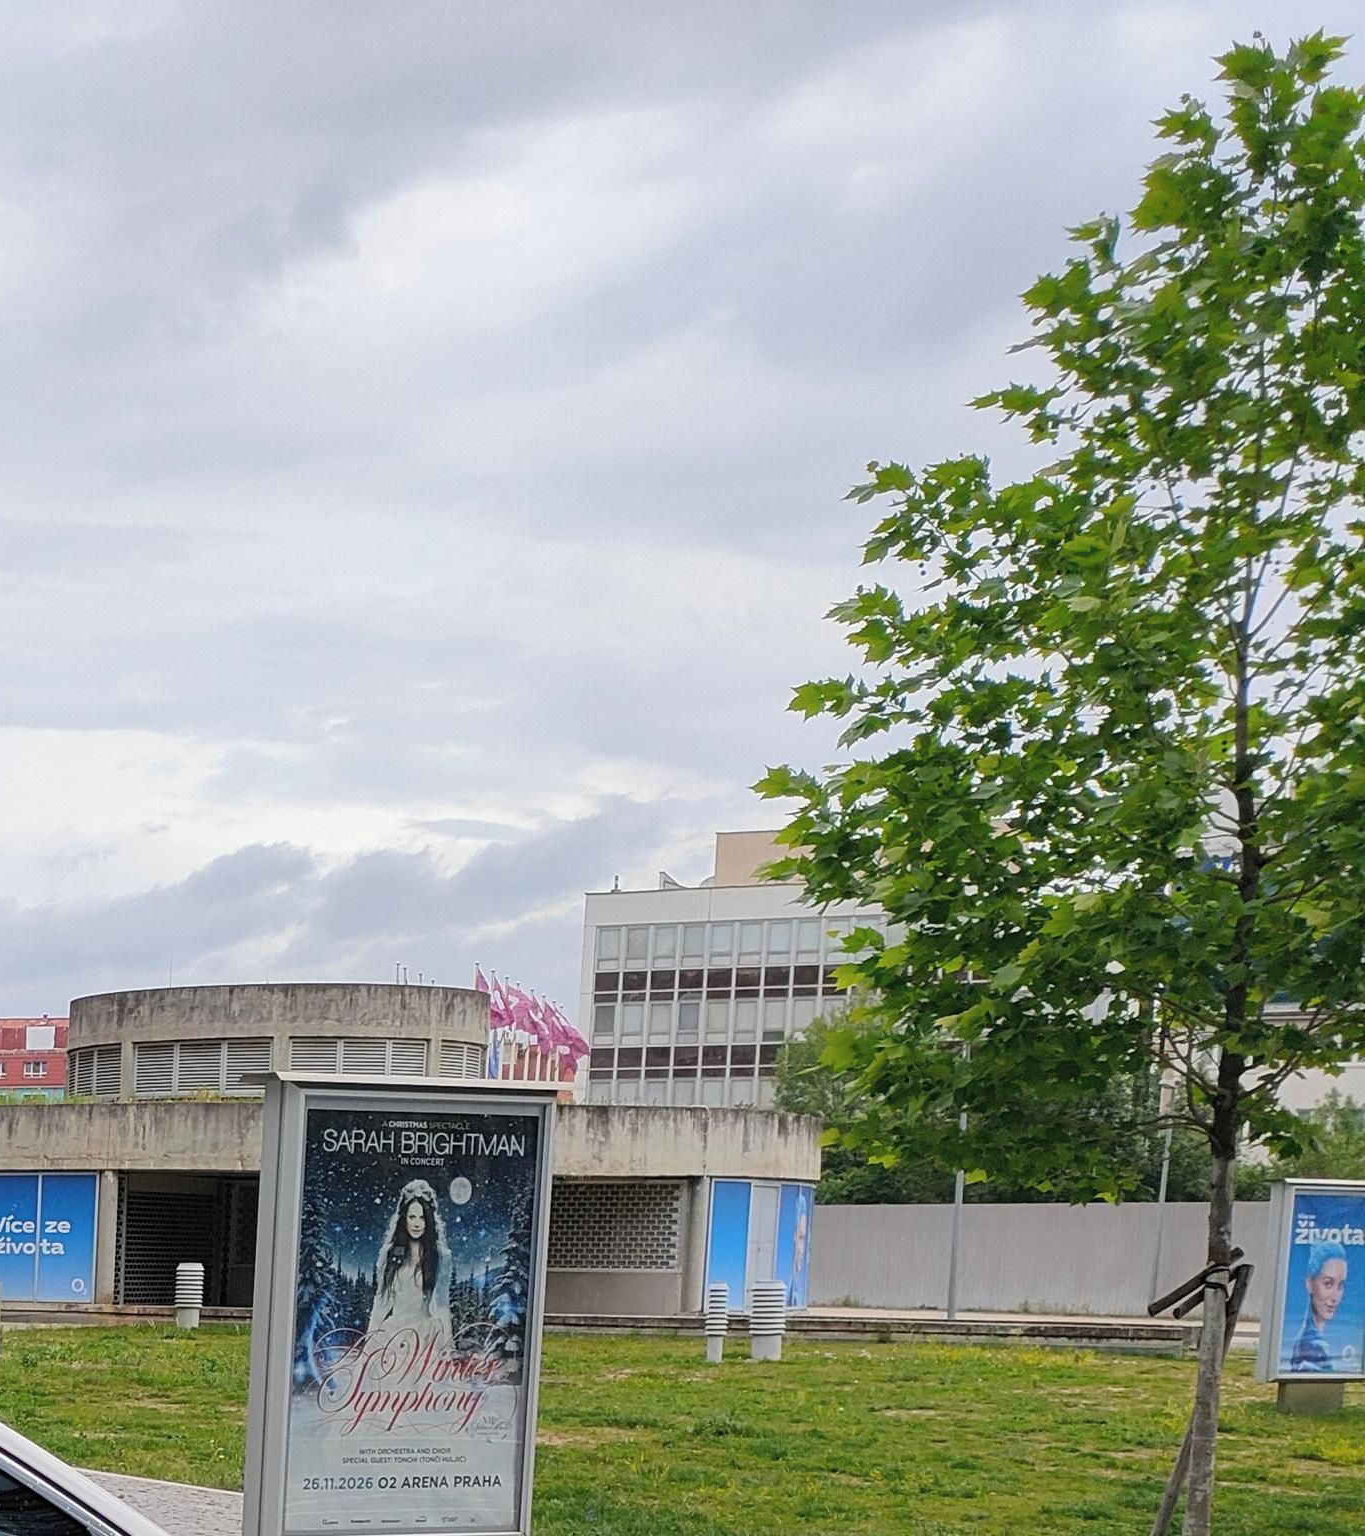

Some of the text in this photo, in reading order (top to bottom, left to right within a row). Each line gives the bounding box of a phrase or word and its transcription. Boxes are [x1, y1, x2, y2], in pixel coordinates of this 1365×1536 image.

[388, 1120, 428, 1129] CHRISTMAS
[428, 1121, 471, 1130] SPECTACLE
[322, 1128, 526, 1157] SARAH BRIGHTMAN
[400, 1157, 445, 1166] IN CONCERT
[44, 1220, 71, 1234] ze
[1295, 1220, 1365, 1246] života
[381, 1328, 503, 1385] Winter
[317, 1348, 485, 1436] Symphony
[303, 1477, 373, 1490] 26.11.2026
[401, 1476, 449, 1489] ARENA
[453, 1475, 502, 1488] PRAHA
